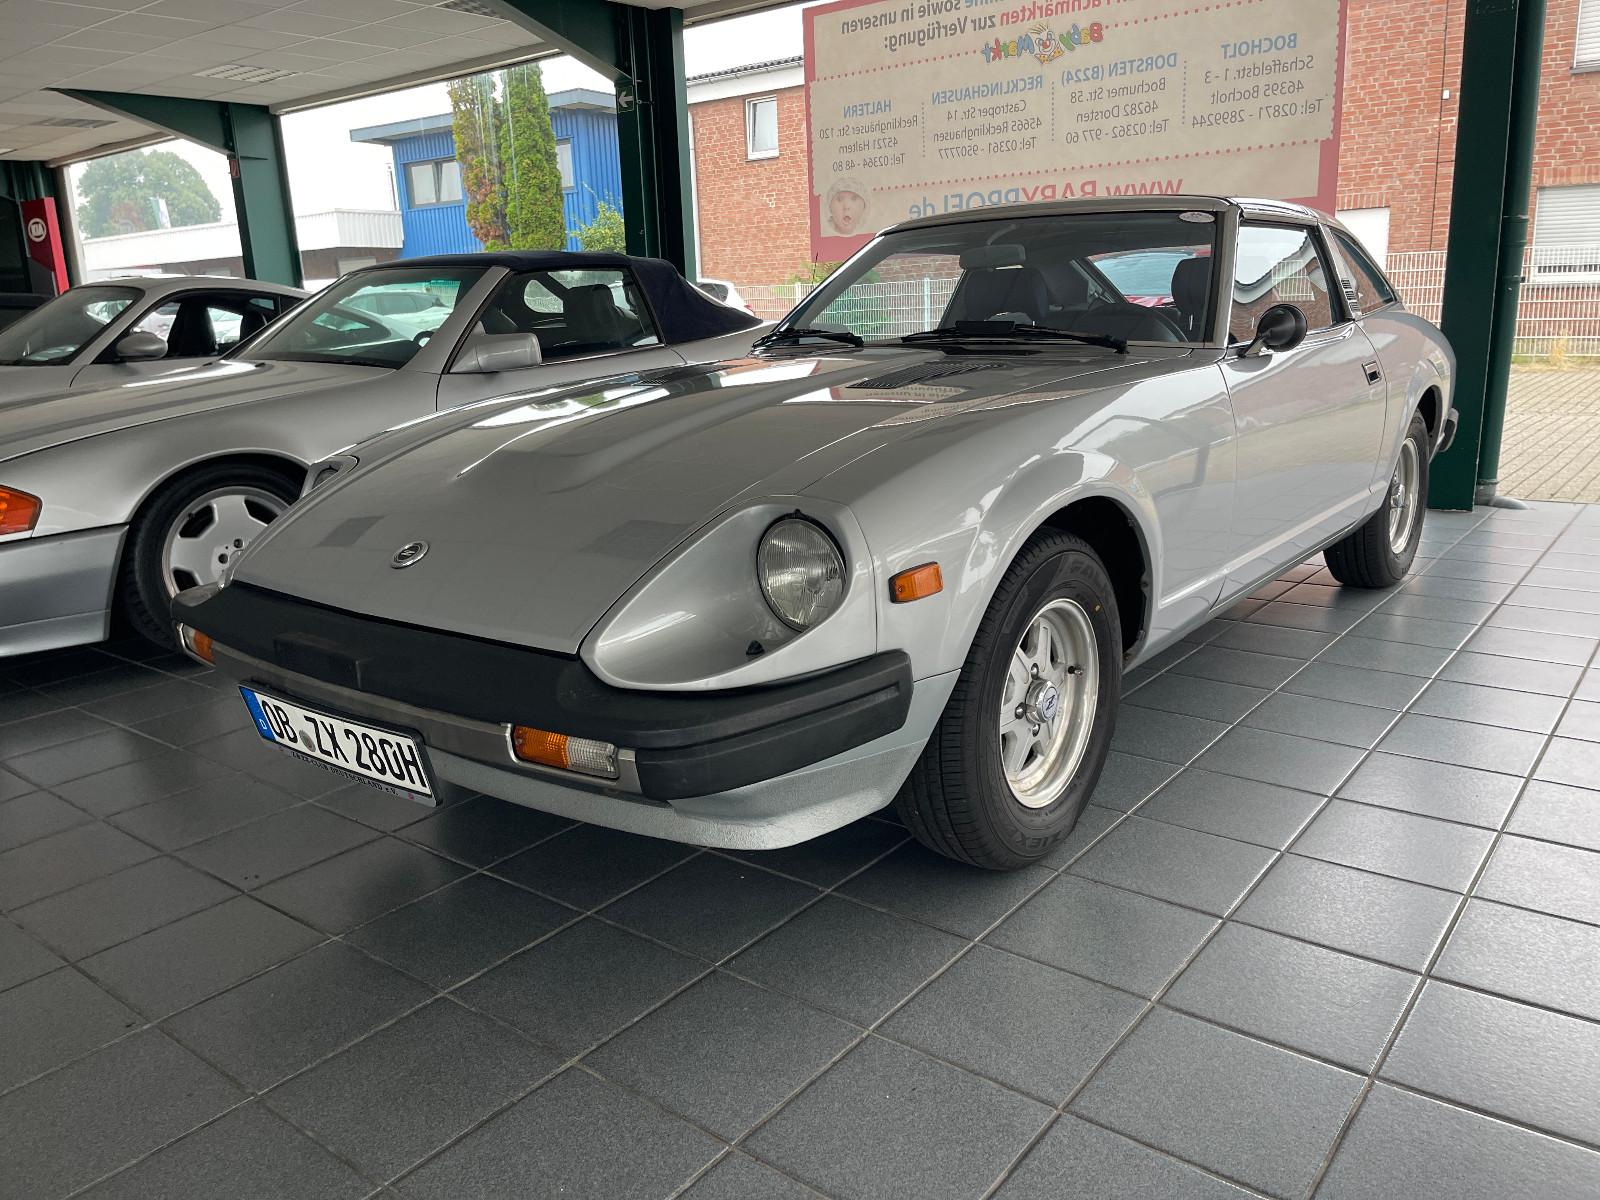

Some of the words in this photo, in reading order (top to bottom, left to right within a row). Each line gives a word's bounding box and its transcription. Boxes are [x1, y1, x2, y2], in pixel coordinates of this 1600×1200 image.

[258, 718, 268, 730] D
[262, 700, 299, 743] OB
[304, 715, 349, 763] ZX
[344, 728, 427, 788] 280H
